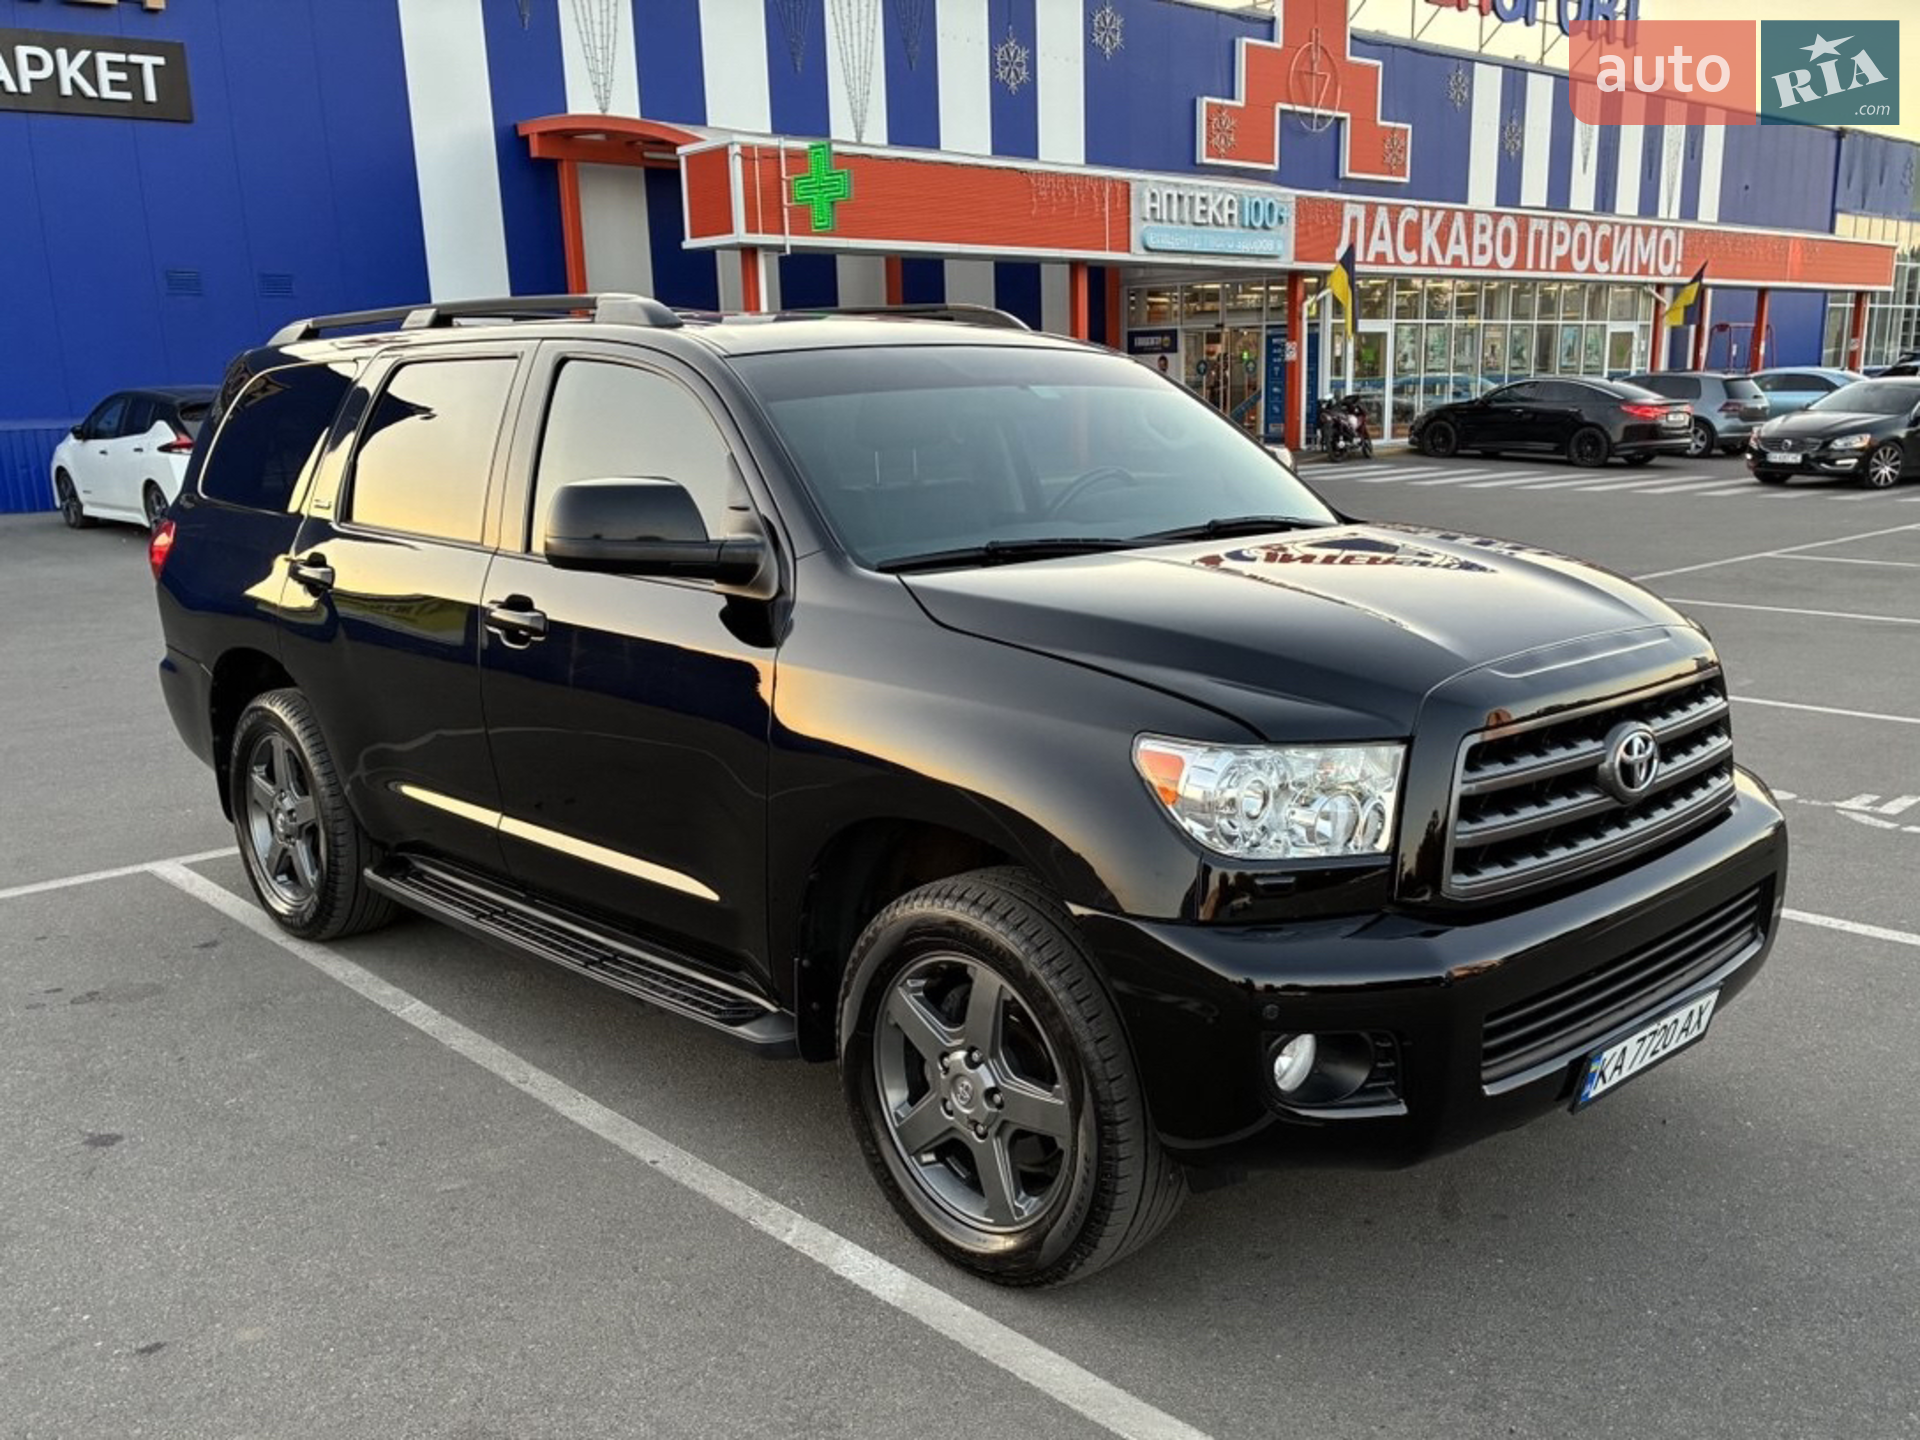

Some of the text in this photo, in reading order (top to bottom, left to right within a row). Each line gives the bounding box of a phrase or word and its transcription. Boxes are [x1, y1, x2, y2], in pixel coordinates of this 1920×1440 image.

[1145, 188, 1238, 225] АПТЕКА
[1335, 203, 1685, 276] ЛАСКАВО ПРОСИМО!
[1593, 1001, 1712, 1090] KA 7720 AX
